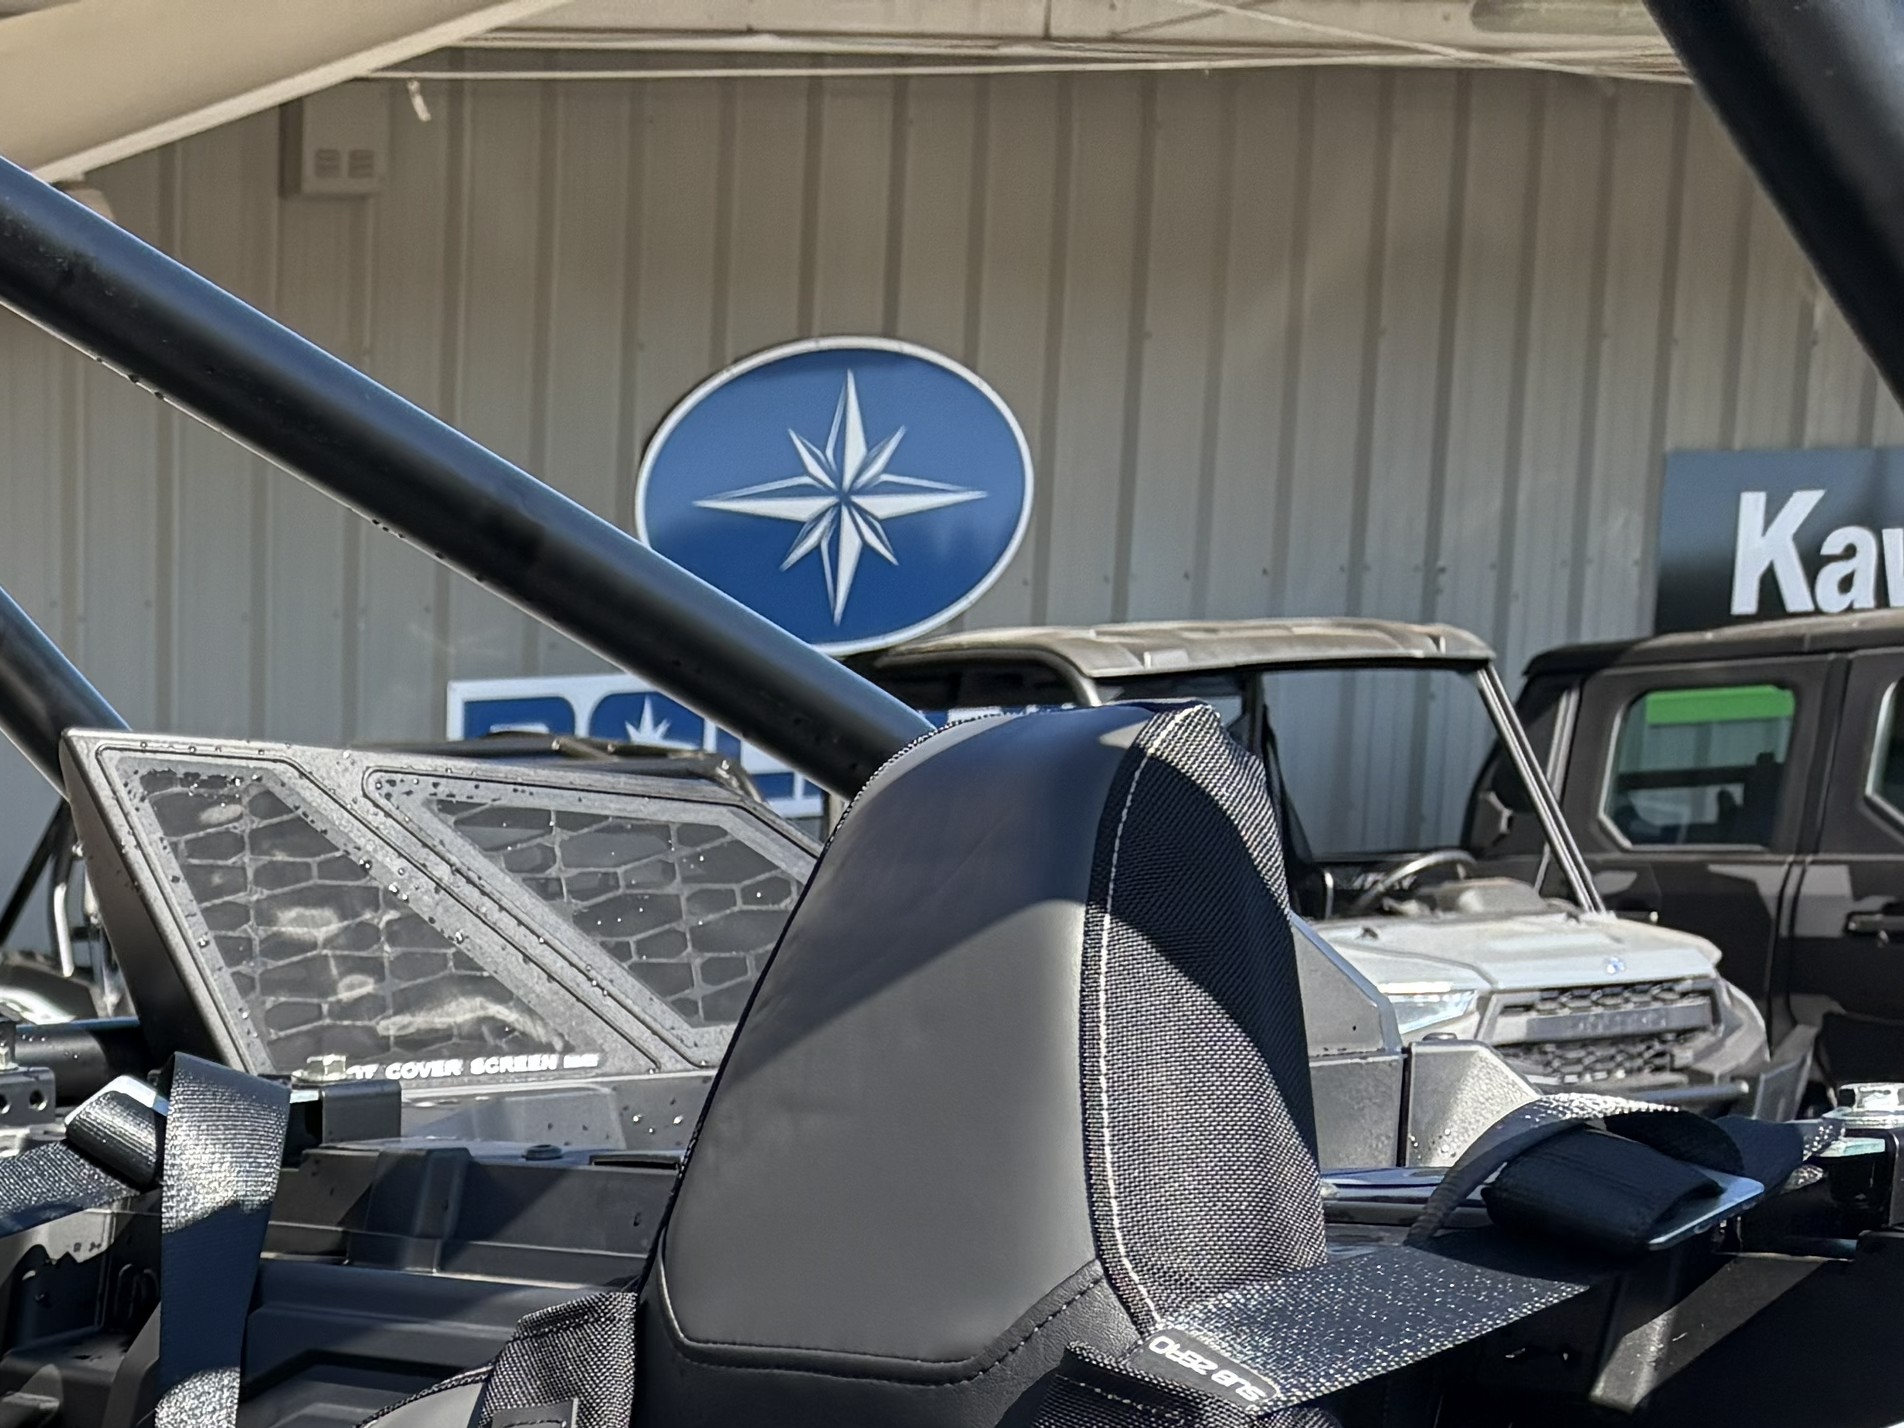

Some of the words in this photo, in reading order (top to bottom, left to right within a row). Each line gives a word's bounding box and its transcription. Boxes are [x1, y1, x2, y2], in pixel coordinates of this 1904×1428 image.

[384, 1058, 463, 1080] COVER
[470, 1054, 558, 1075] SCREEN
[1148, 1335, 1218, 1376] ZERO
[1211, 1369, 1267, 1402] SUB
